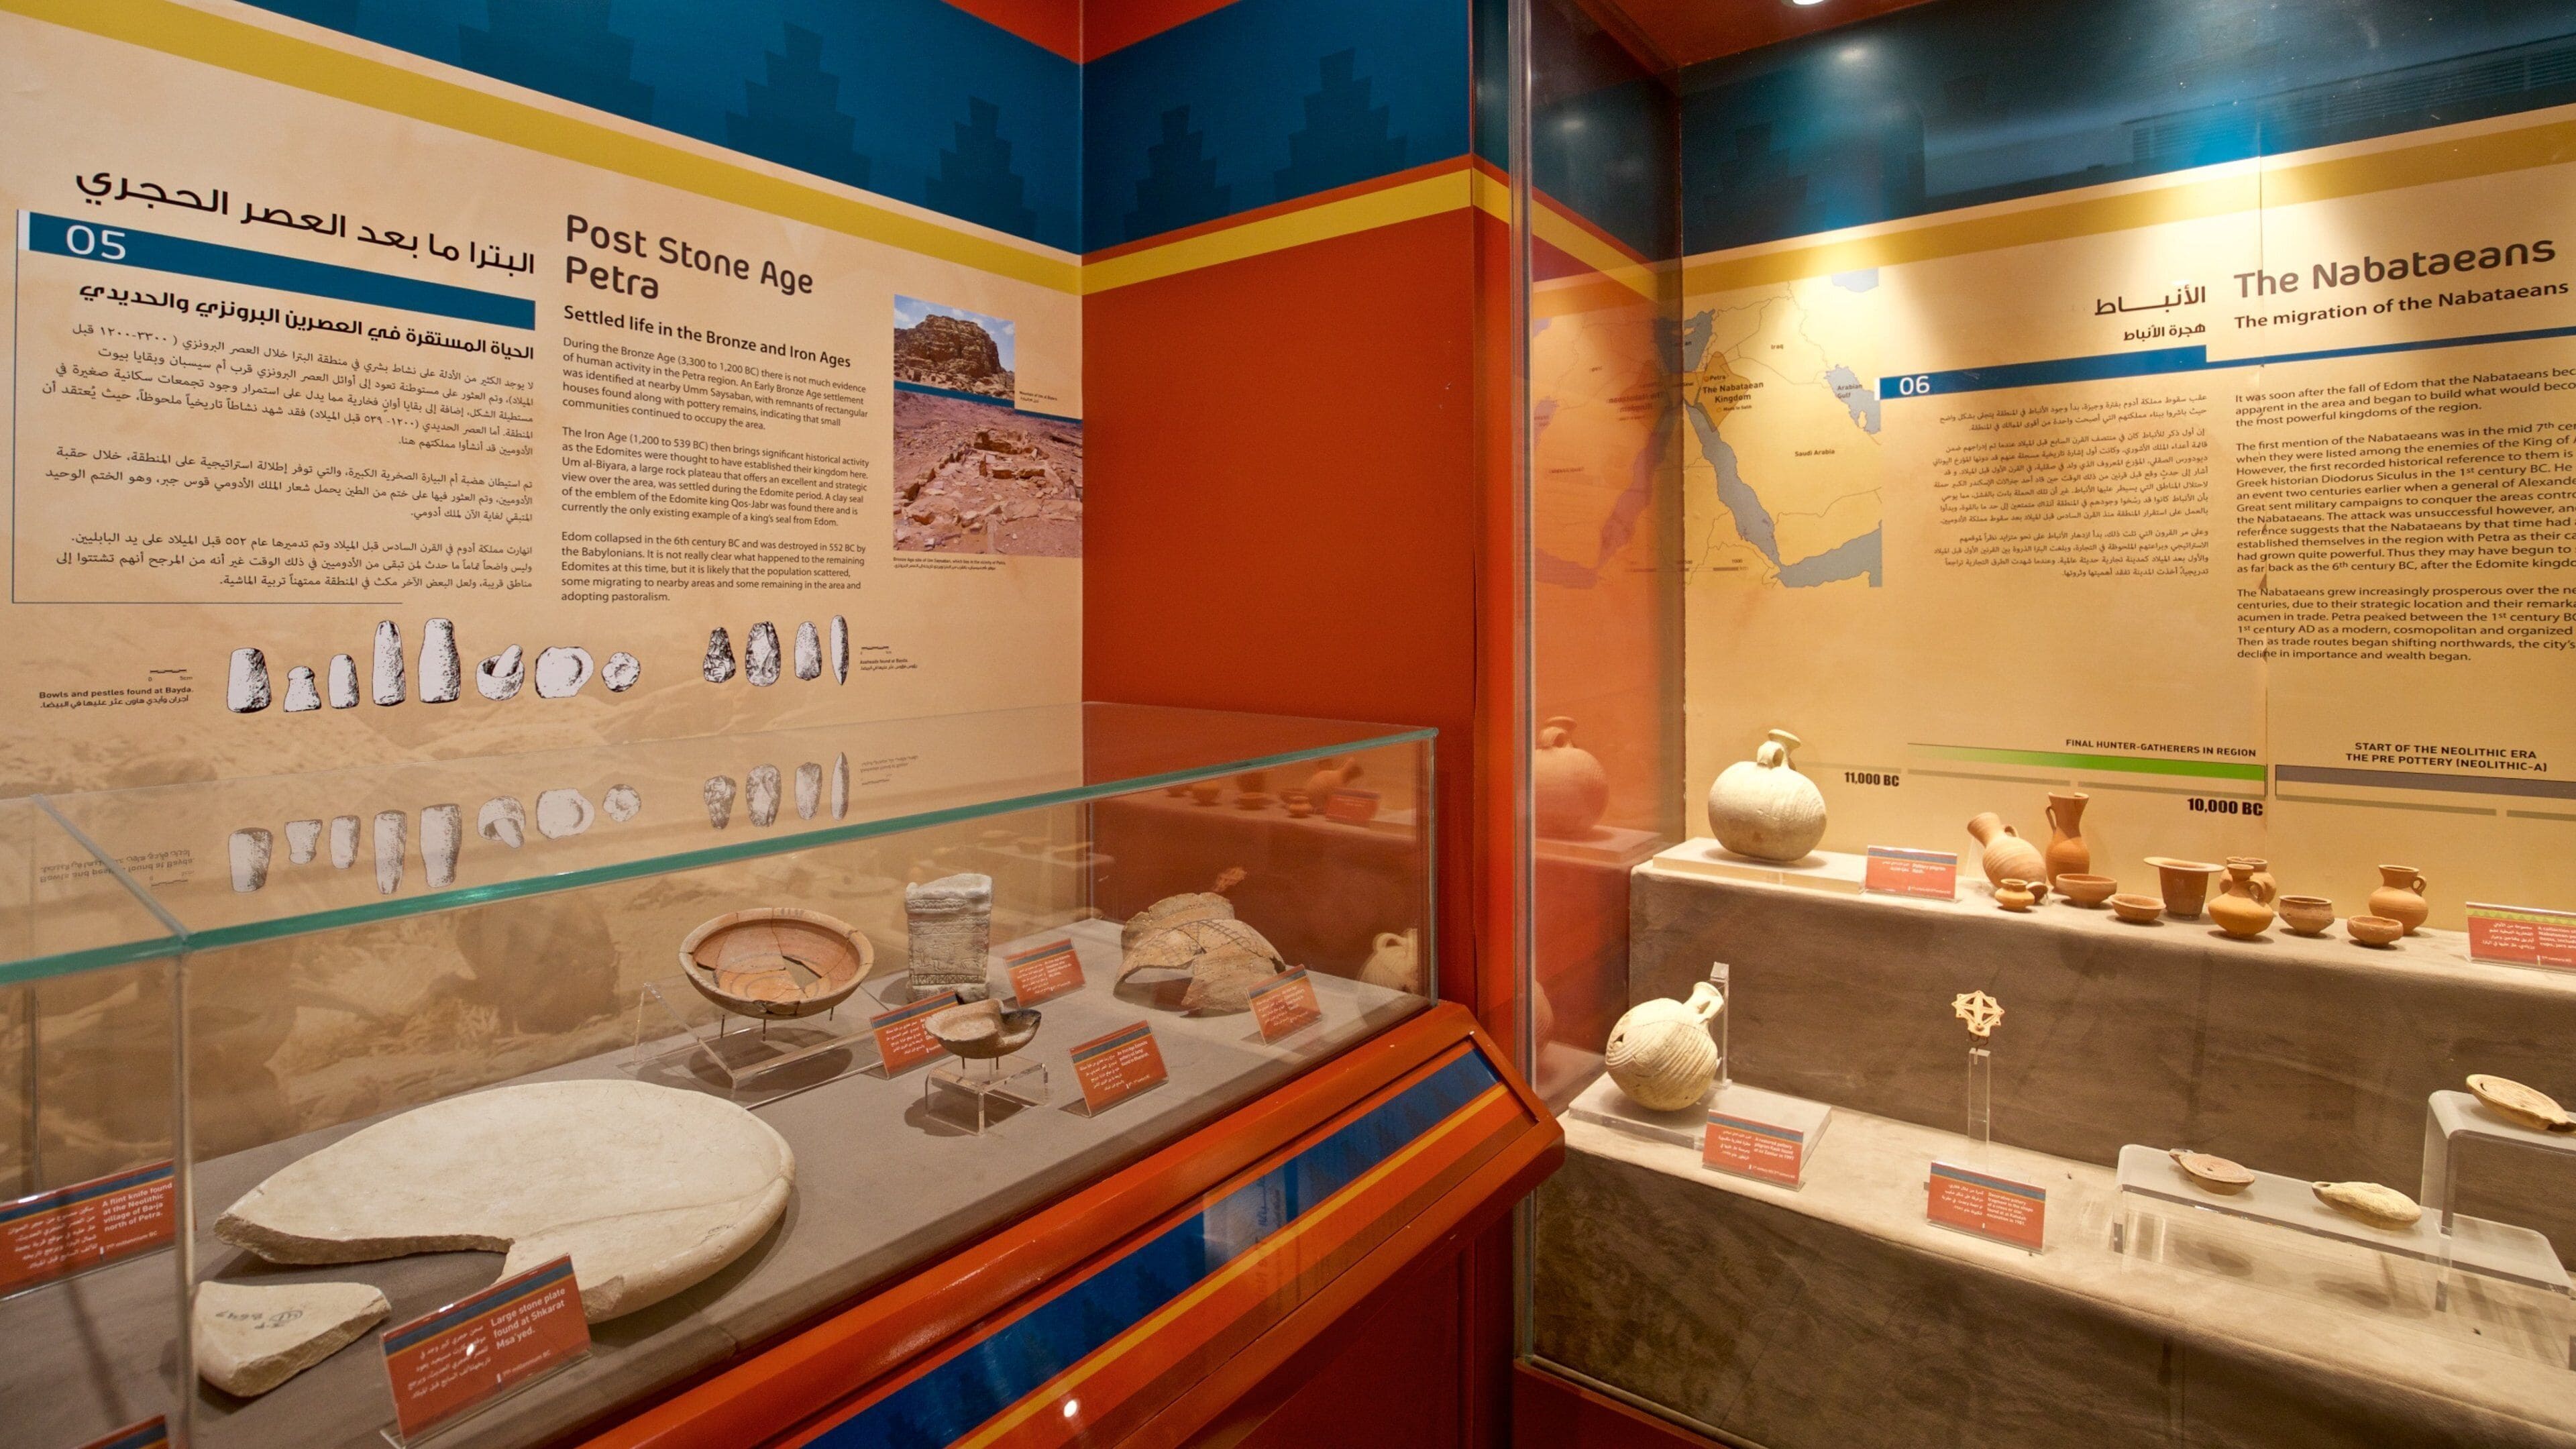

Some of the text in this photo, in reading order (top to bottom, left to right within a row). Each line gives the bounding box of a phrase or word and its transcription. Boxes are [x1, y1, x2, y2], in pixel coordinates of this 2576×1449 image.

[76, 172, 534, 277] البترا ما بعد العصر الحجري
[66, 223, 127, 262] 05
[567, 214, 813, 296] Post Stone Age
[566, 256, 659, 299] Petra
[2233, 240, 2556, 298] The Nabataeans
[2234, 283, 2569, 329] The migration of the Nabataeans
[79, 285, 534, 360] الحياة المستقرة في العصرين البرونزي والحديدي
[564, 305, 851, 368] Settled life in the Bronze and Iron Ages
[2123, 323, 2206, 341] هجرة الأنباط
[563, 337, 867, 393] During the Bronze Age (3,300 to 1,200 BC) there is not much evidence
[562, 353, 864, 405] of human activity in the Petra region. An Early Bronze Age settlement
[1709, 374, 1727, 382] Petra
[1900, 375, 1930, 396] 06
[1702, 382, 1764, 394] The Nabataean
[1837, 392, 1851, 400] Gulf
[1715, 393, 1752, 405] Kingdom
[562, 399, 765, 430] communities continued to occupy the area.
[2235, 402, 2482, 427] the most powerful kingdoms of the region.
[398, 436, 416, 445] هنا.
[419, 439, 456, 450] مملكتهم
[486, 444, 496, 452] قد
[498, 445, 533, 456] الأدوميين
[561, 591, 670, 604] adopting pastoralism.
[2237, 649, 2471, 662] decline in importance and wealth began.
[91, 689, 125, 698] pestles
[166, 686, 194, 695] Bayda.
[70, 700, 82, 709] في
[83, 699, 107, 707] عليها
[2065, 739, 2256, 757] FINAL HUNTER-GATHERERS IN REGION
[2355, 743, 2392, 751] START
[2413, 745, 2437, 754] THE
[2441, 746, 2507, 757] NEOLITHIC
[2511, 749, 2537, 759] ERA
[2345, 753, 2547, 772] THE PRE POTTERY (NEOLITHIC-A)
[1844, 771, 1900, 786] 11,000 BC
[2187, 798, 2263, 816] 10,000 BC
[109, 1195, 127, 1205] flint
[128, 1190, 148, 1199] knife
[150, 1182, 173, 1193] found
[127, 1193, 164, 1208] Neolithic
[104, 1212, 131, 1224] village
[104, 1220, 128, 1232] north
[128, 1217, 137, 1225] of
[490, 1288, 566, 1327] Large stone plate
[493, 1320, 519, 1338] found
[521, 1316, 530, 1326] at
